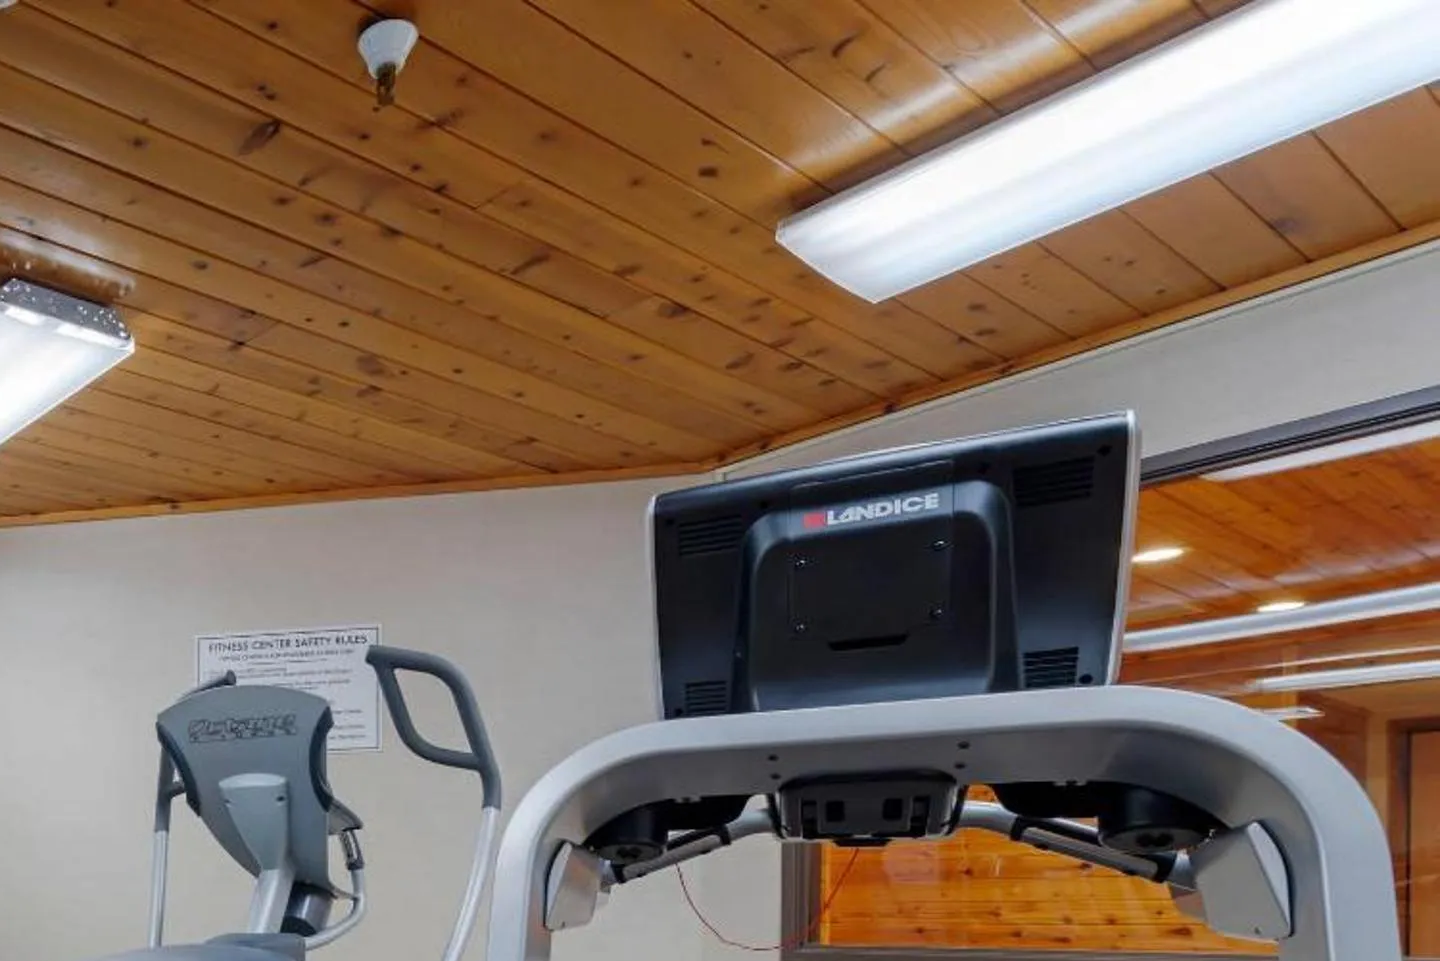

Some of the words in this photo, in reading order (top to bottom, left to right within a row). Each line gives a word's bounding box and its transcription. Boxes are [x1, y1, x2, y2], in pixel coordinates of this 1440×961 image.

[826, 492, 939, 526] LANDICE
[208, 640, 249, 654] FITNESS
[252, 637, 291, 650] CENTER
[295, 635, 331, 648] SAFETY
[335, 634, 368, 646] RULES
